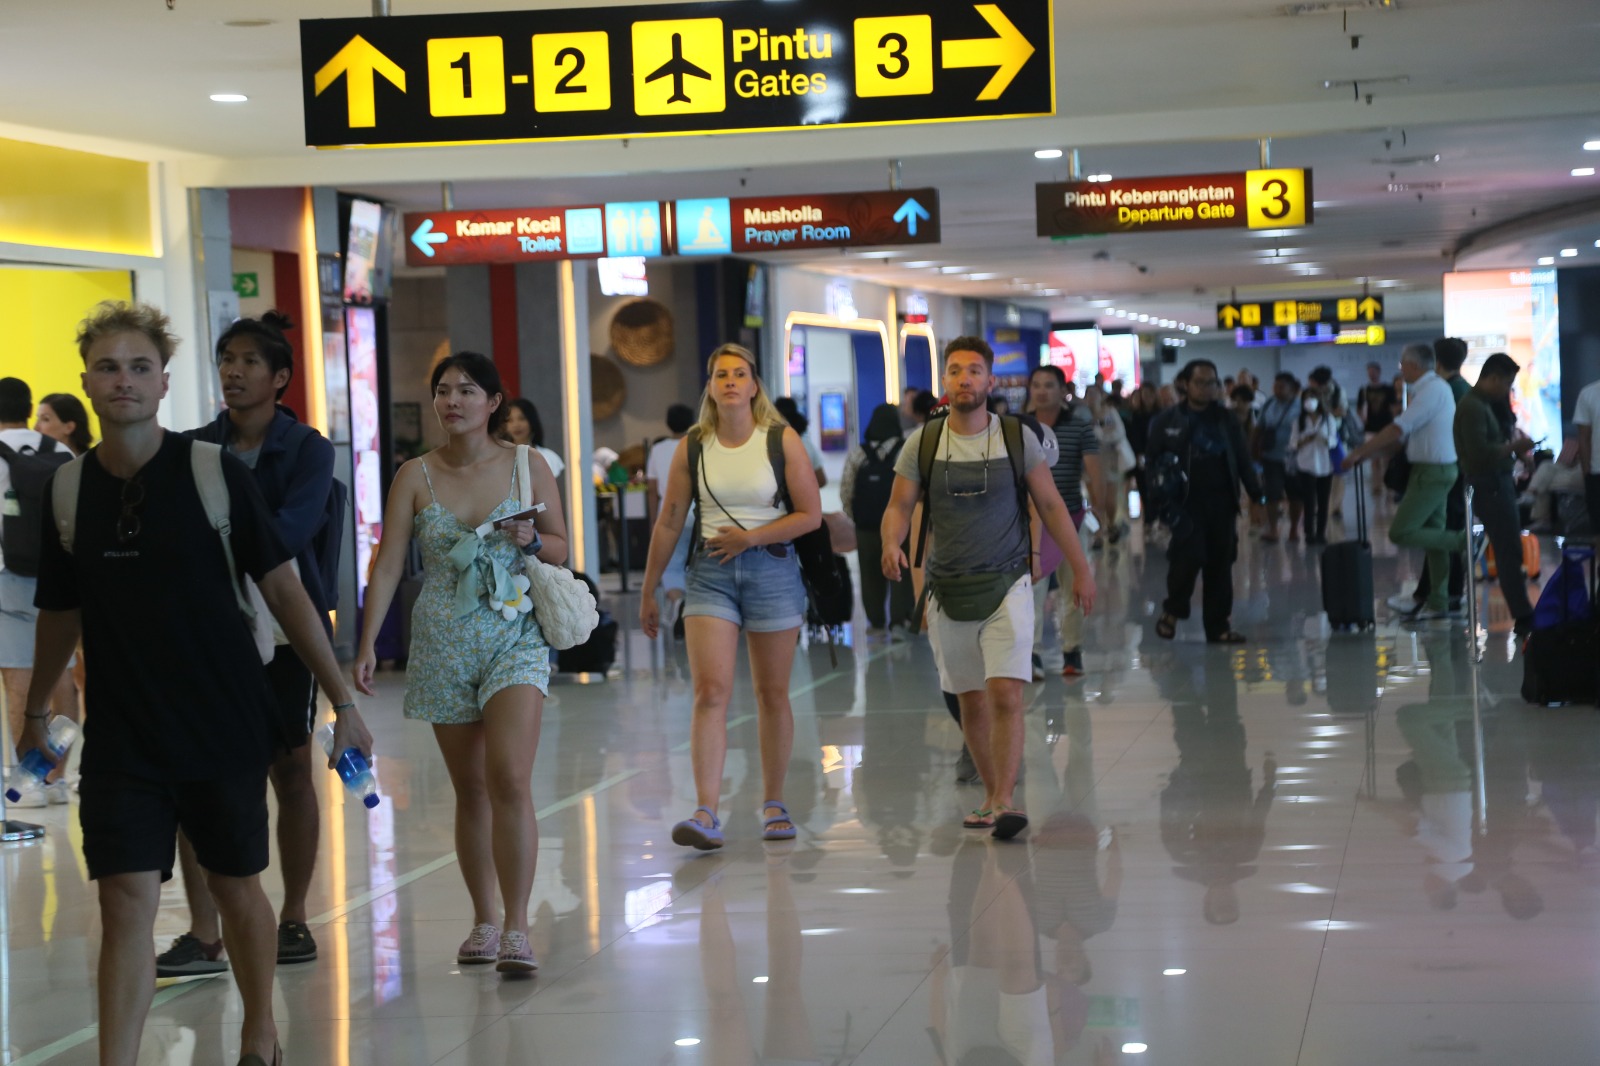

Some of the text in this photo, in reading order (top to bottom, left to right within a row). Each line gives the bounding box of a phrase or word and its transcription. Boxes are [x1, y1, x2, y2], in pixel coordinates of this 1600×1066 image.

[732, 28, 832, 63] Pintu
[876, 32, 910, 79] 3
[734, 69, 827, 98] Gates
[1064, 185, 1235, 207] Pintu Keberangkatan
[1260, 179, 1291, 219] 3
[744, 205, 823, 225] Musholla
[1118, 202, 1235, 225] Departure Gate
[456, 216, 561, 237] Kamar Kecil
[745, 224, 850, 246] Prayer Room
[518, 236, 562, 253] Toilet
